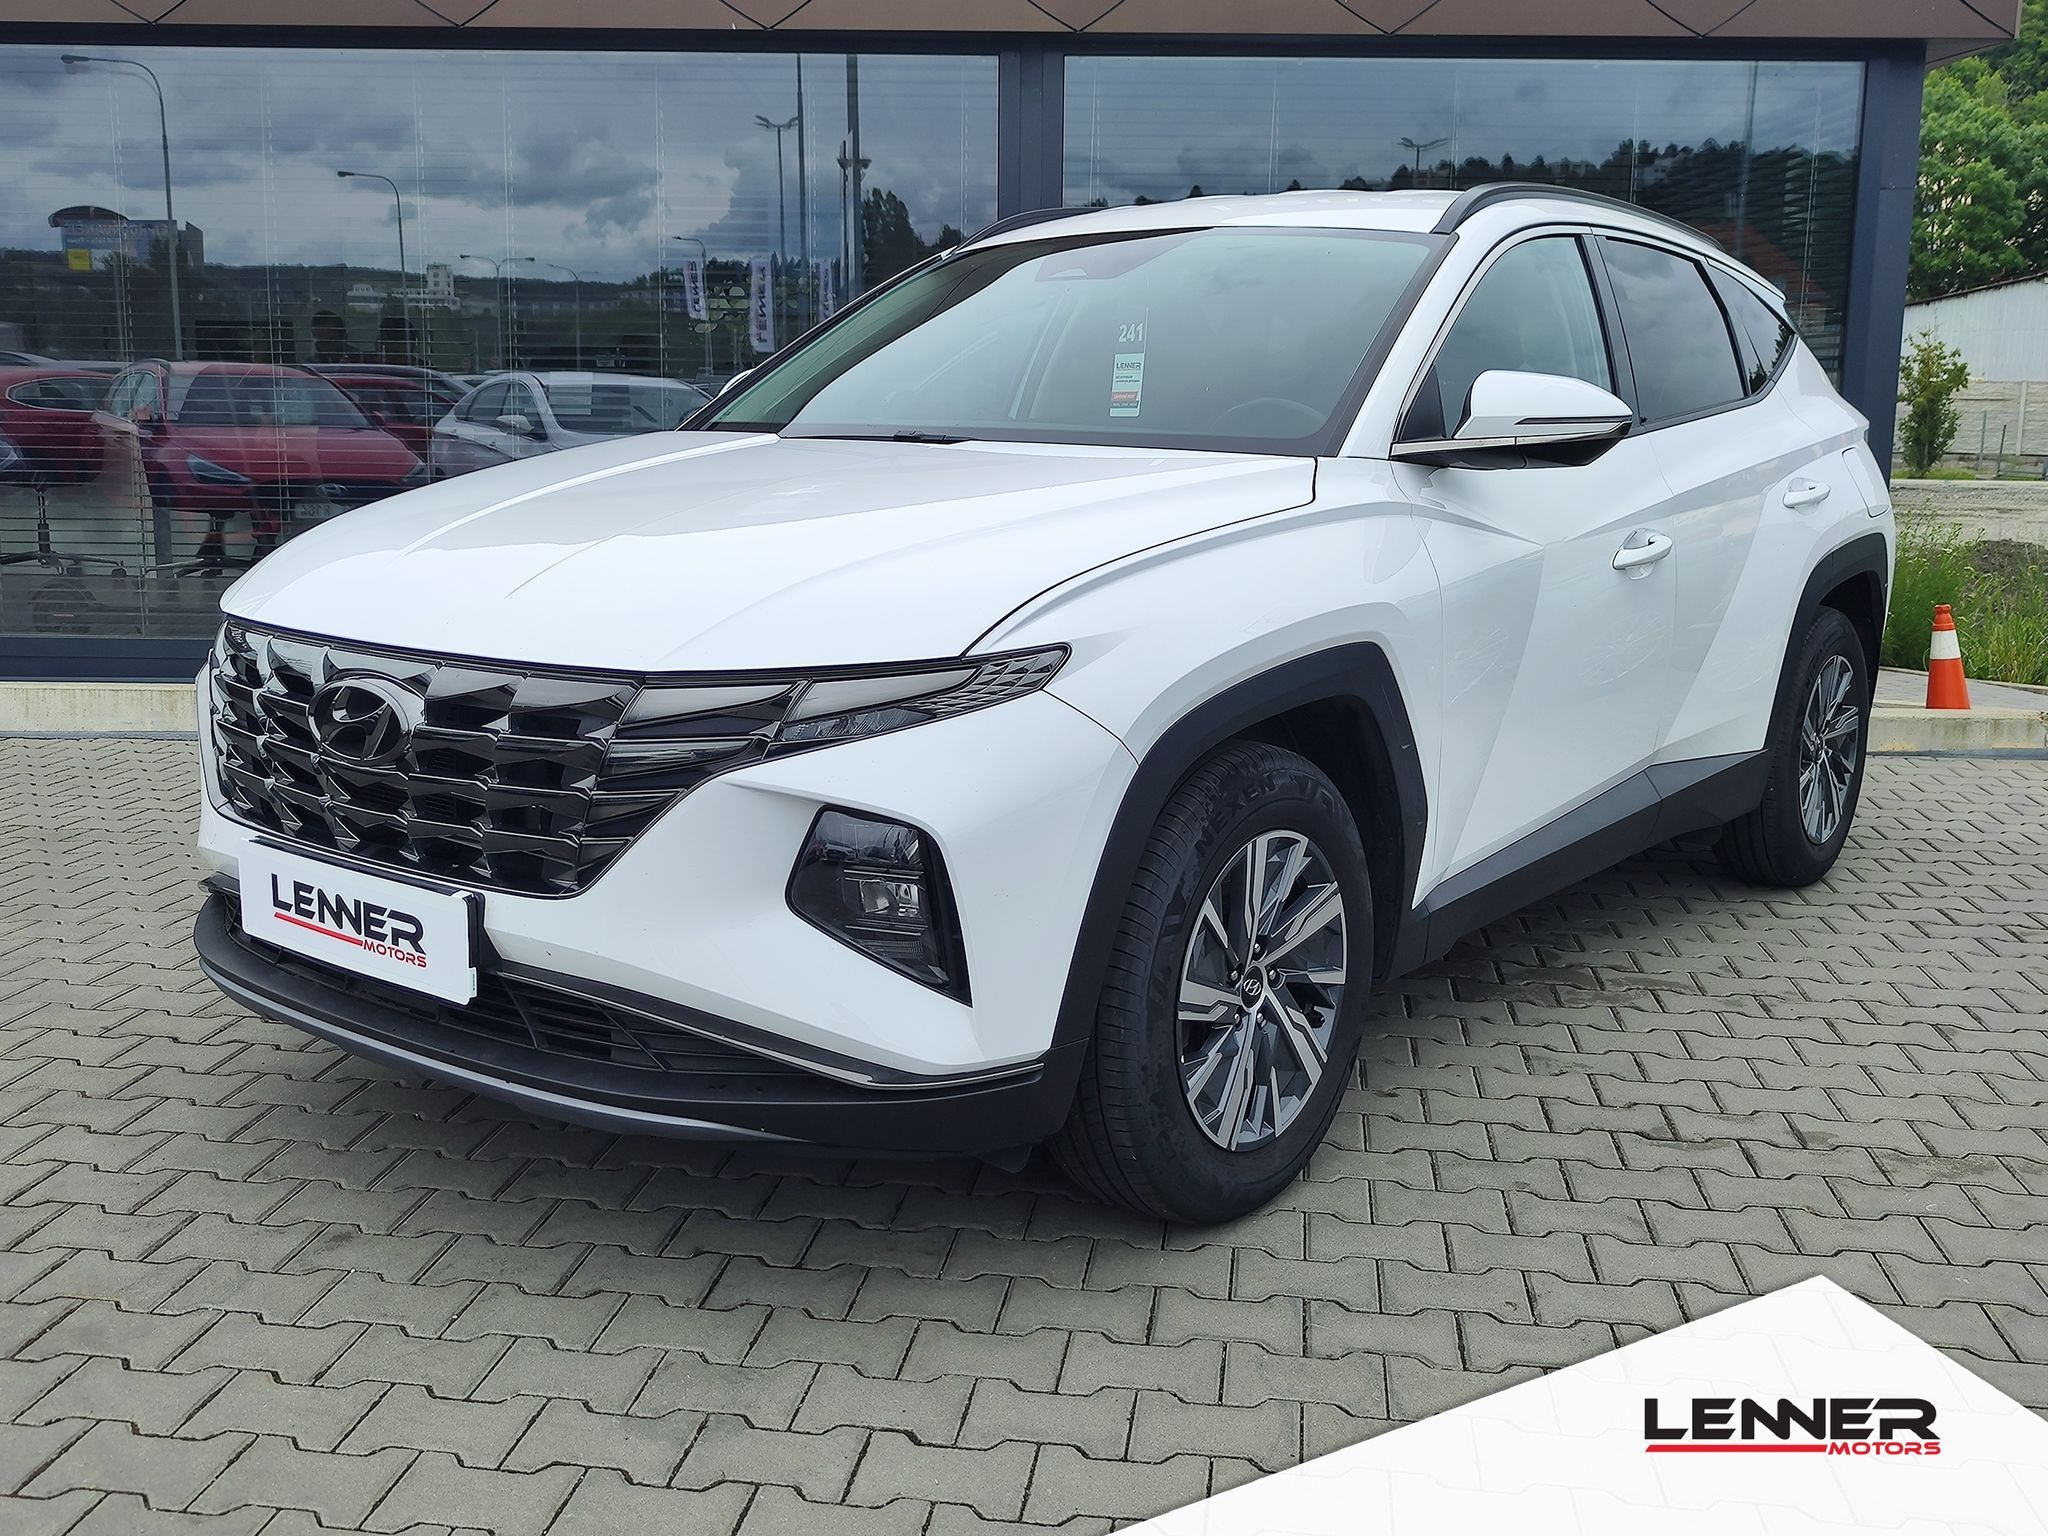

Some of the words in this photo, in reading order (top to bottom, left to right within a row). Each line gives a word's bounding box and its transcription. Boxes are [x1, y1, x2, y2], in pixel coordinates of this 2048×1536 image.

[1119, 323, 1143, 343] 241
[1116, 362, 1142, 370] LENNER
[271, 873, 427, 954] LENNER
[363, 939, 427, 968] MOTORS
